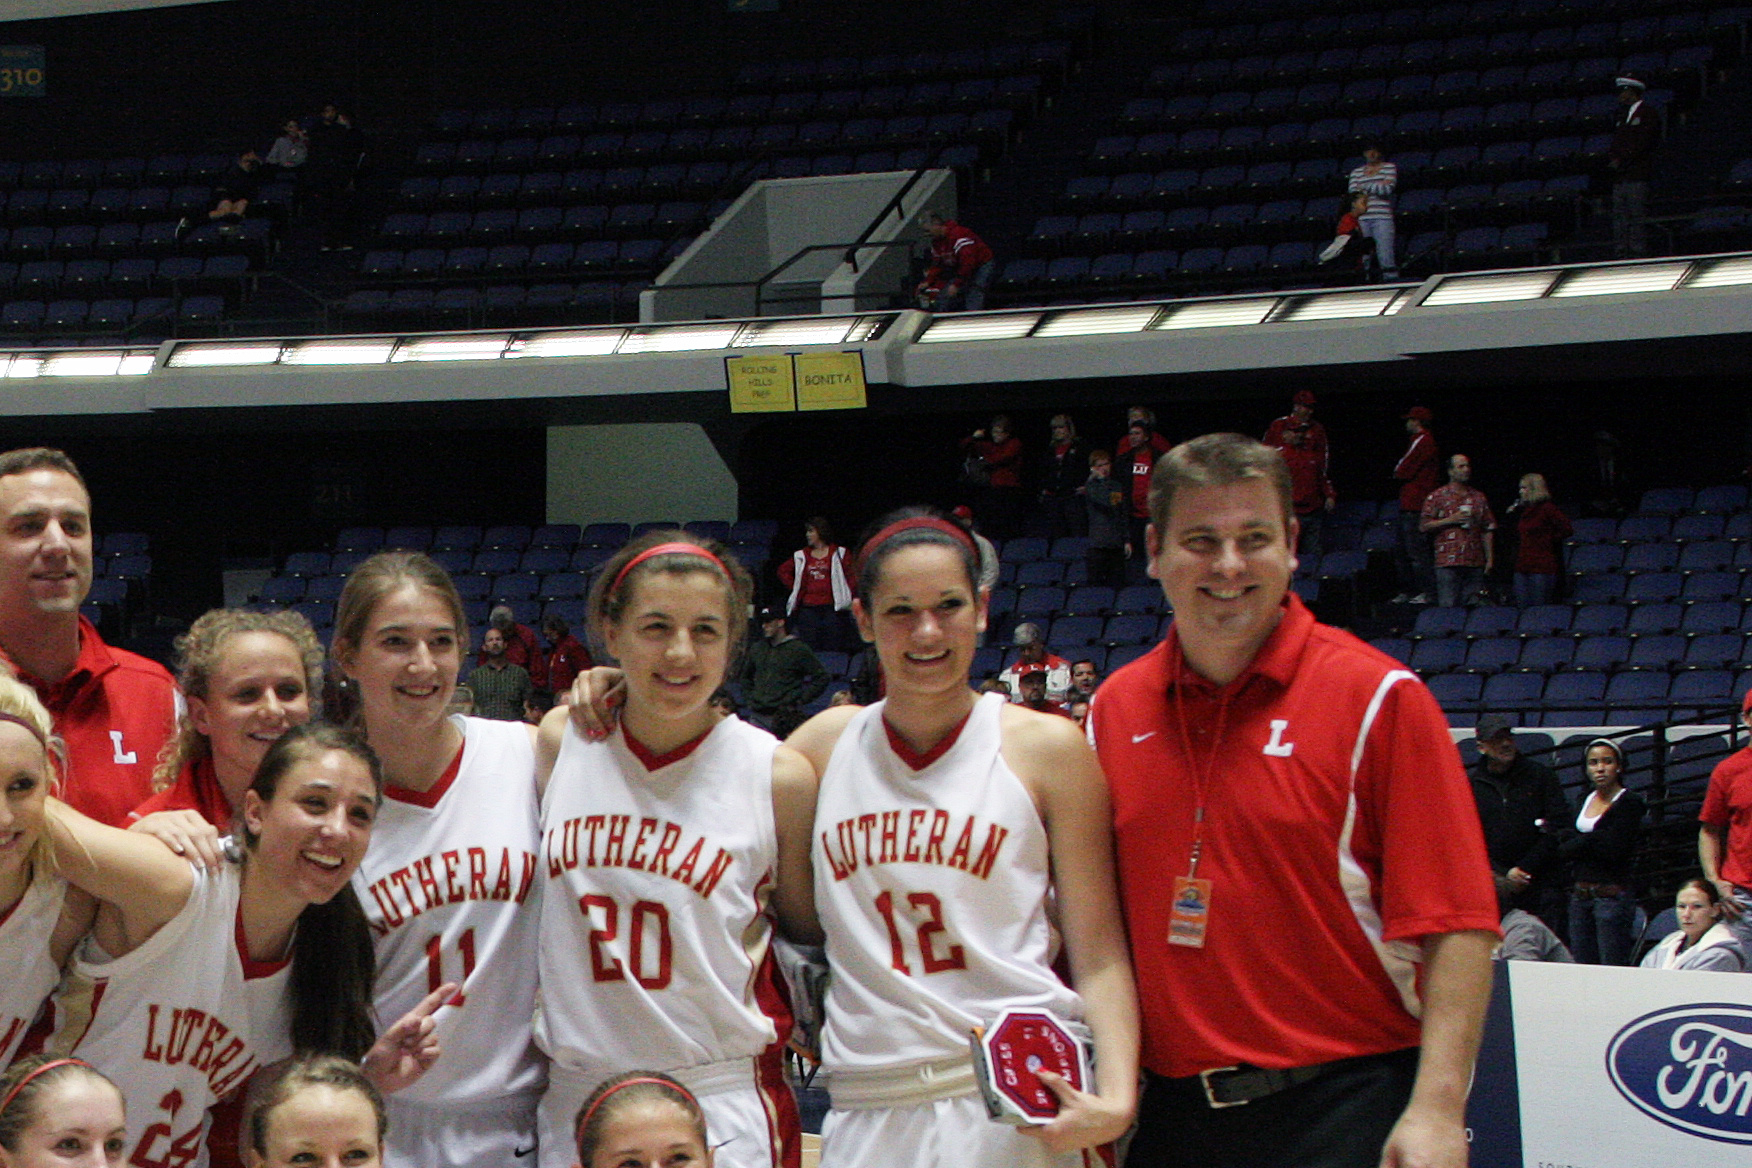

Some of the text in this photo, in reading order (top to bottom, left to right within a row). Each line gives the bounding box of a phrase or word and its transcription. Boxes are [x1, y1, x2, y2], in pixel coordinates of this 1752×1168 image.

[0, 68, 43, 92] 310
[804, 373, 852, 386] BONITA
[109, 730, 138, 764] L
[1262, 719, 1295, 757] L
[547, 815, 735, 900] LUTHERAN
[821, 808, 1009, 882] LUTHERAN
[424, 928, 476, 1007] 11
[580, 893, 673, 991] 20
[872, 890, 967, 977] 12
